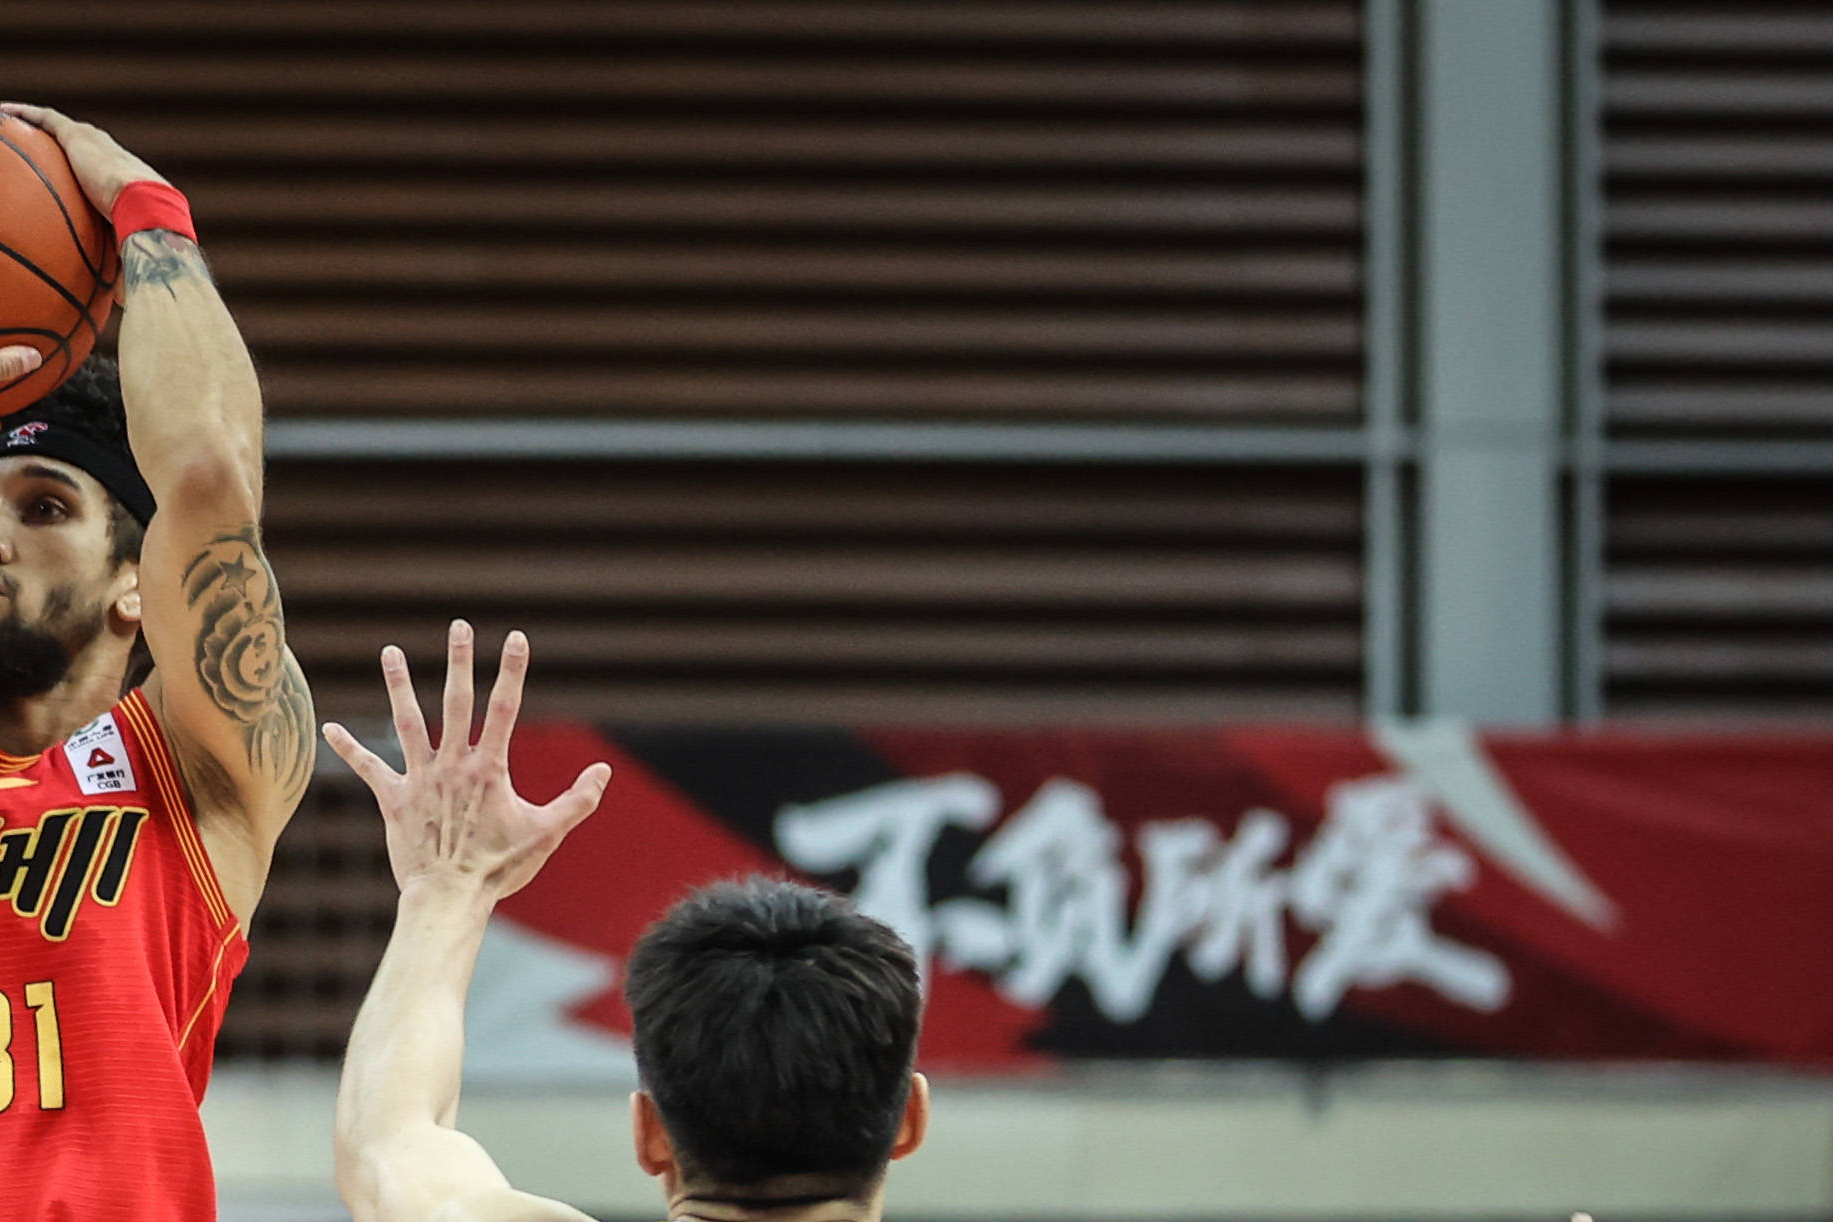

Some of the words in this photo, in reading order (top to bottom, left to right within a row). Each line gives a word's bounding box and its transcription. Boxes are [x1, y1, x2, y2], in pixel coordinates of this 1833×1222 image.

[97, 780, 122, 791] CGB
[773, 772, 1512, 1023] 不负所爱
